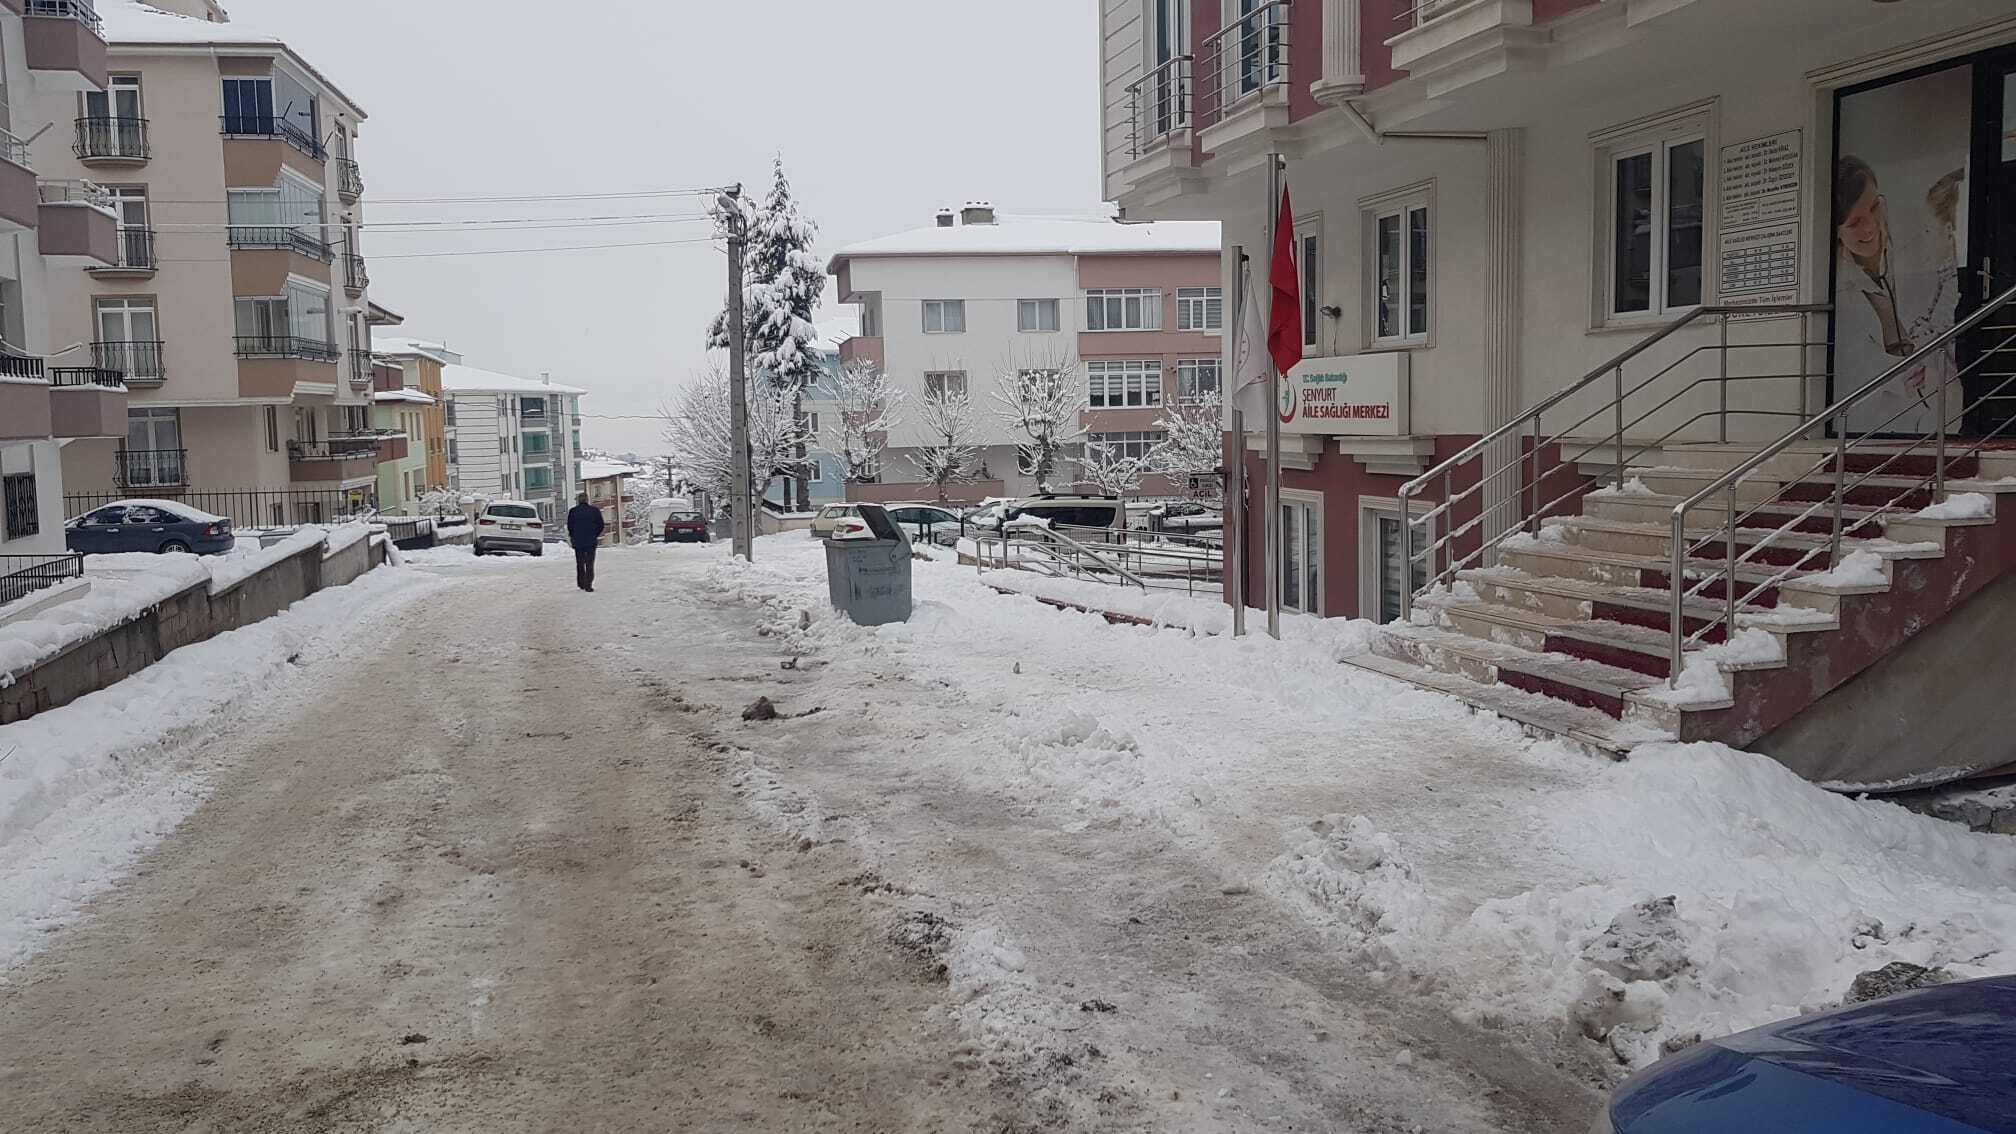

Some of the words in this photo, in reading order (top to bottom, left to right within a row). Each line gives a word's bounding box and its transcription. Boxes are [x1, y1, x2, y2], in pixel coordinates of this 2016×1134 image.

[1302, 387, 1337, 405] ŞENYURT
[1302, 403, 1319, 418] AİLE
[1319, 402, 1351, 419] SAĞLIĞI
[1352, 401, 1390, 420] MERKEZİ
